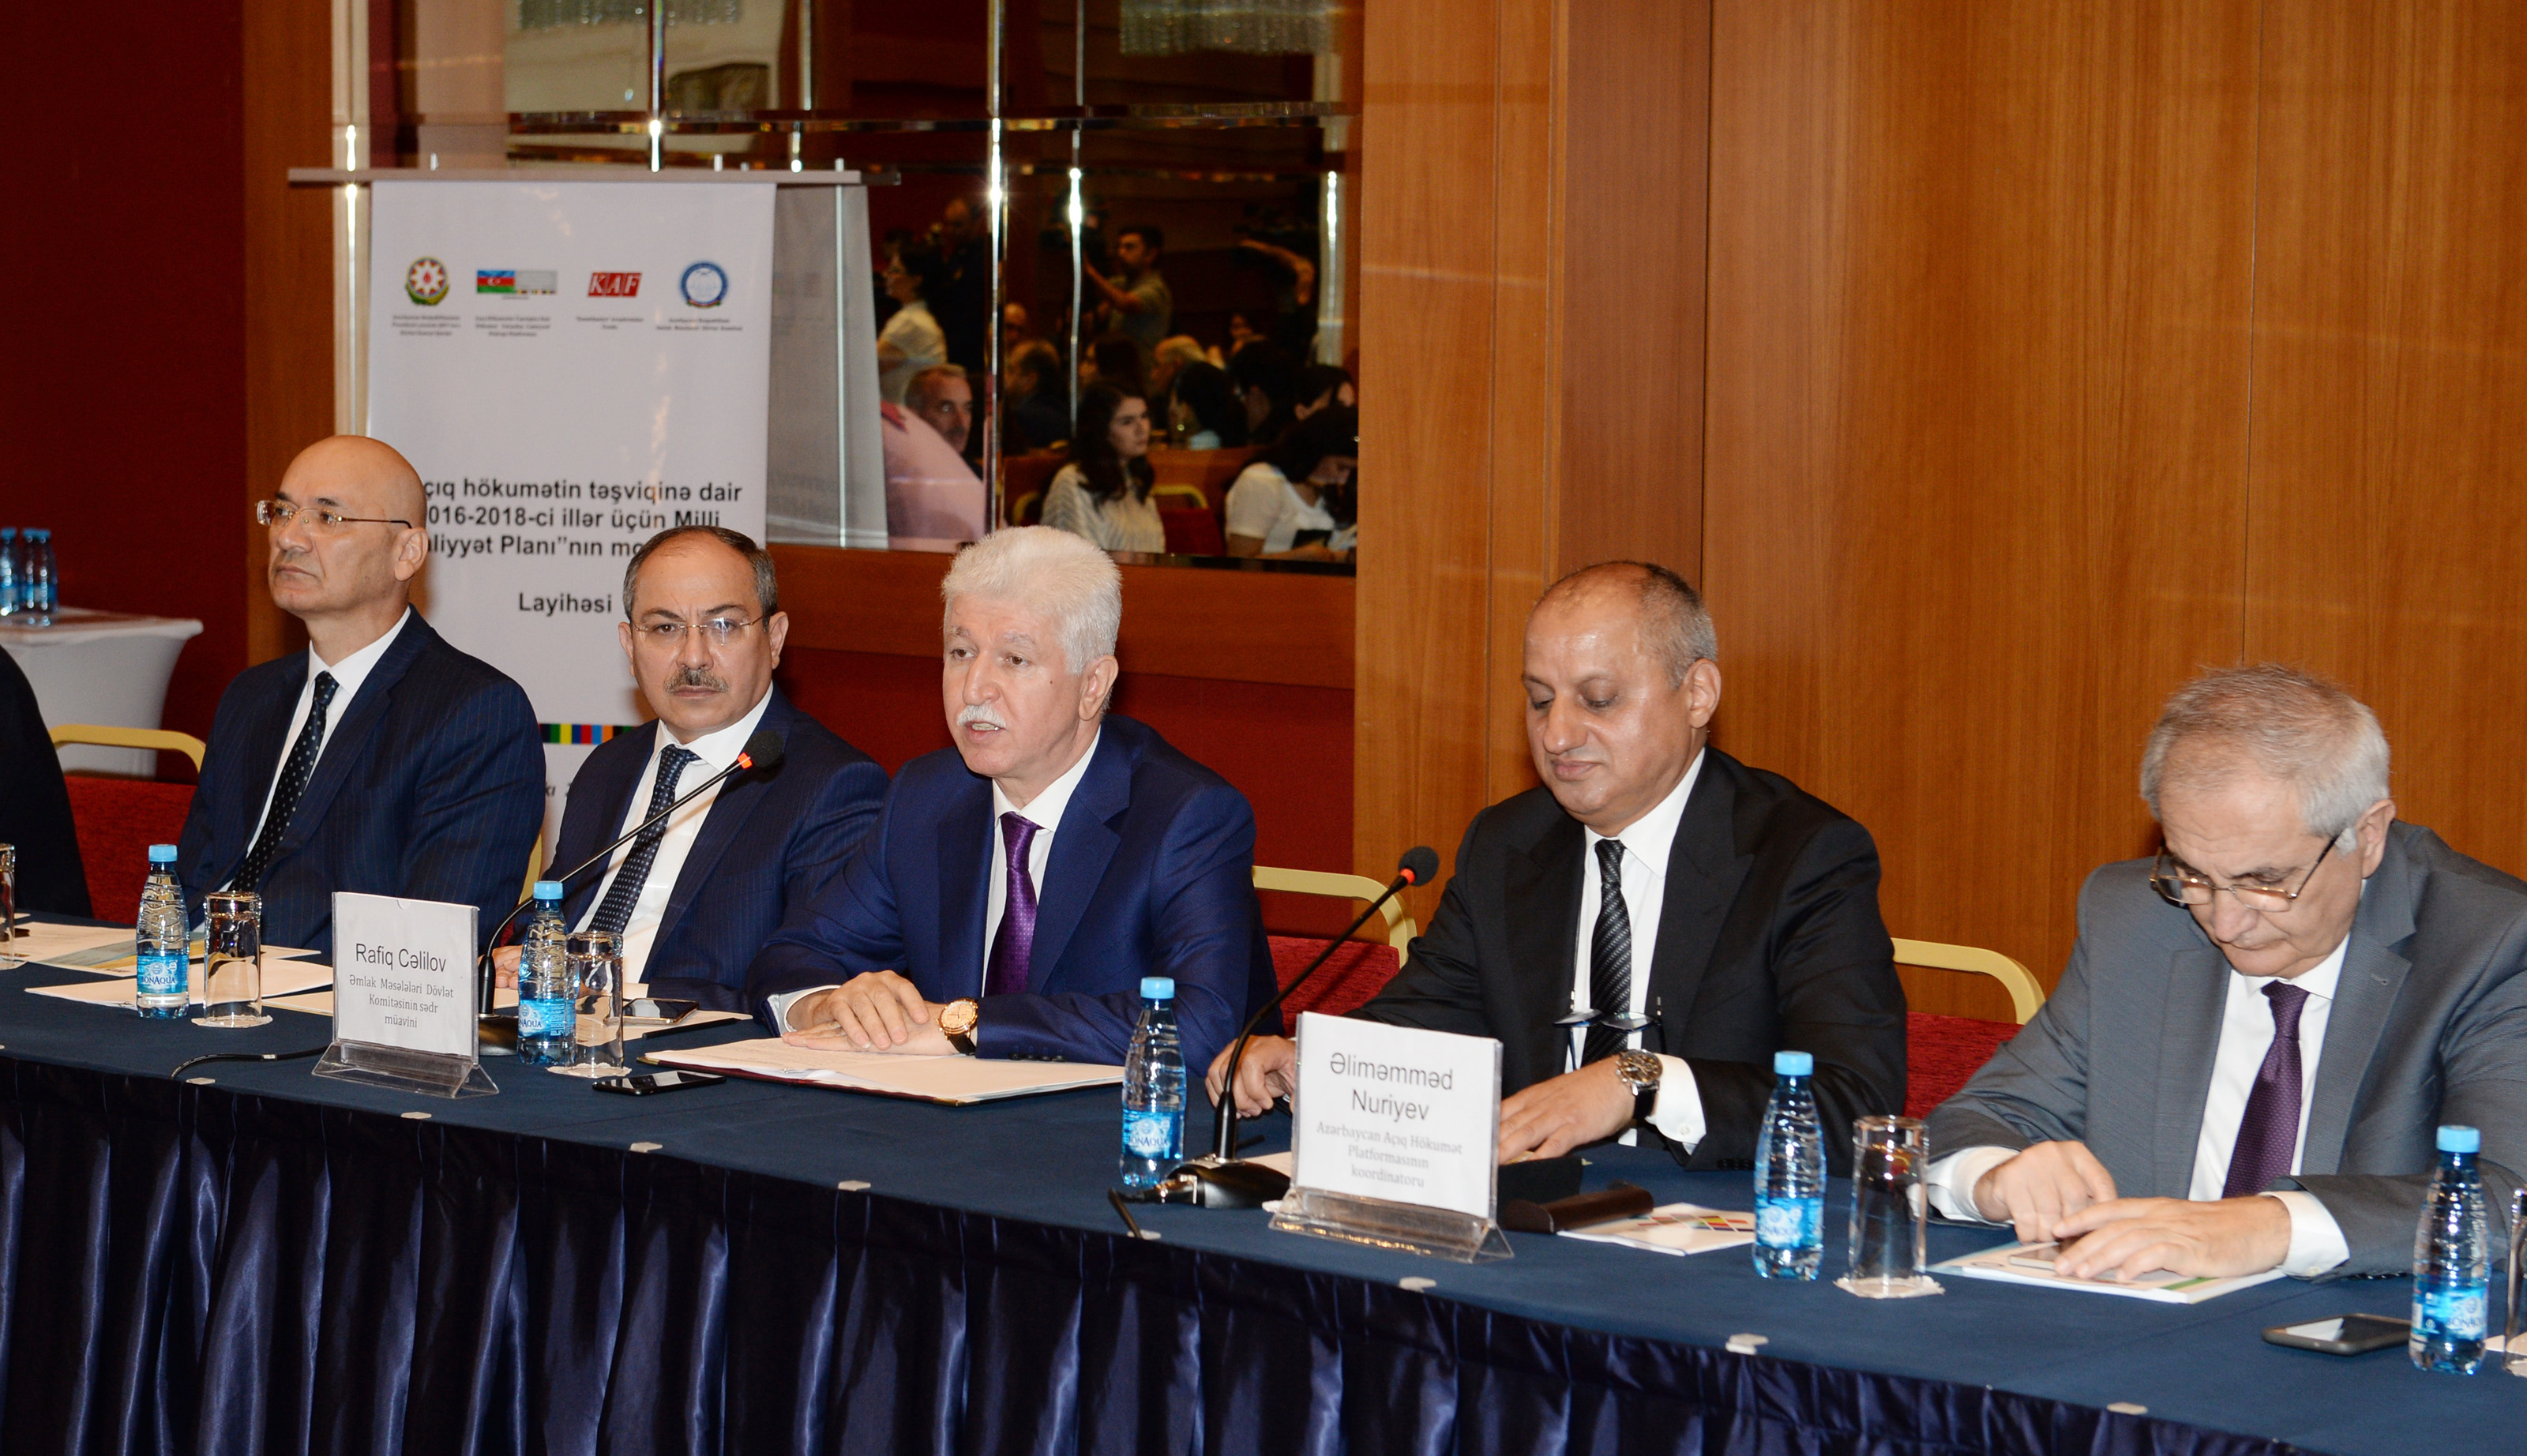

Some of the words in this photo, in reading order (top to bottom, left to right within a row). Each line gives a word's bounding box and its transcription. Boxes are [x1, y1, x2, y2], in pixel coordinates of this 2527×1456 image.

[590, 273, 640, 296] KAF
[424, 482, 455, 501] çıq
[464, 478, 580, 499] hökumətin
[589, 480, 692, 505] təşviqinə
[699, 482, 742, 501] dair
[428, 505, 554, 527] 016-2018-ci
[562, 508, 603, 528] illər
[611, 510, 666, 534] üçün
[675, 511, 719, 527] Milli
[519, 592, 612, 614] Layihəsi
[356, 944, 393, 971] Rafiq
[398, 948, 447, 973] Cəlilov
[349, 974, 377, 989] Əmlak
[380, 978, 422, 994] Məsələləri
[426, 985, 454, 998] Dövlət
[369, 993, 418, 1011] Komitəsinin
[419, 1001, 439, 1014] sədr
[385, 1015, 418, 1029] müavini
[1330, 1052, 1453, 1090] Əliməmməd
[1352, 1089, 1429, 1123] Nuriyev
[1316, 1121, 1381, 1143] Azərbaycan
[1384, 1131, 1407, 1150] Açıq
[1410, 1135, 1463, 1155] Hökumət
[1348, 1144, 1429, 1169] Platformasının
[1351, 1164, 1425, 1188] koordinatoru
